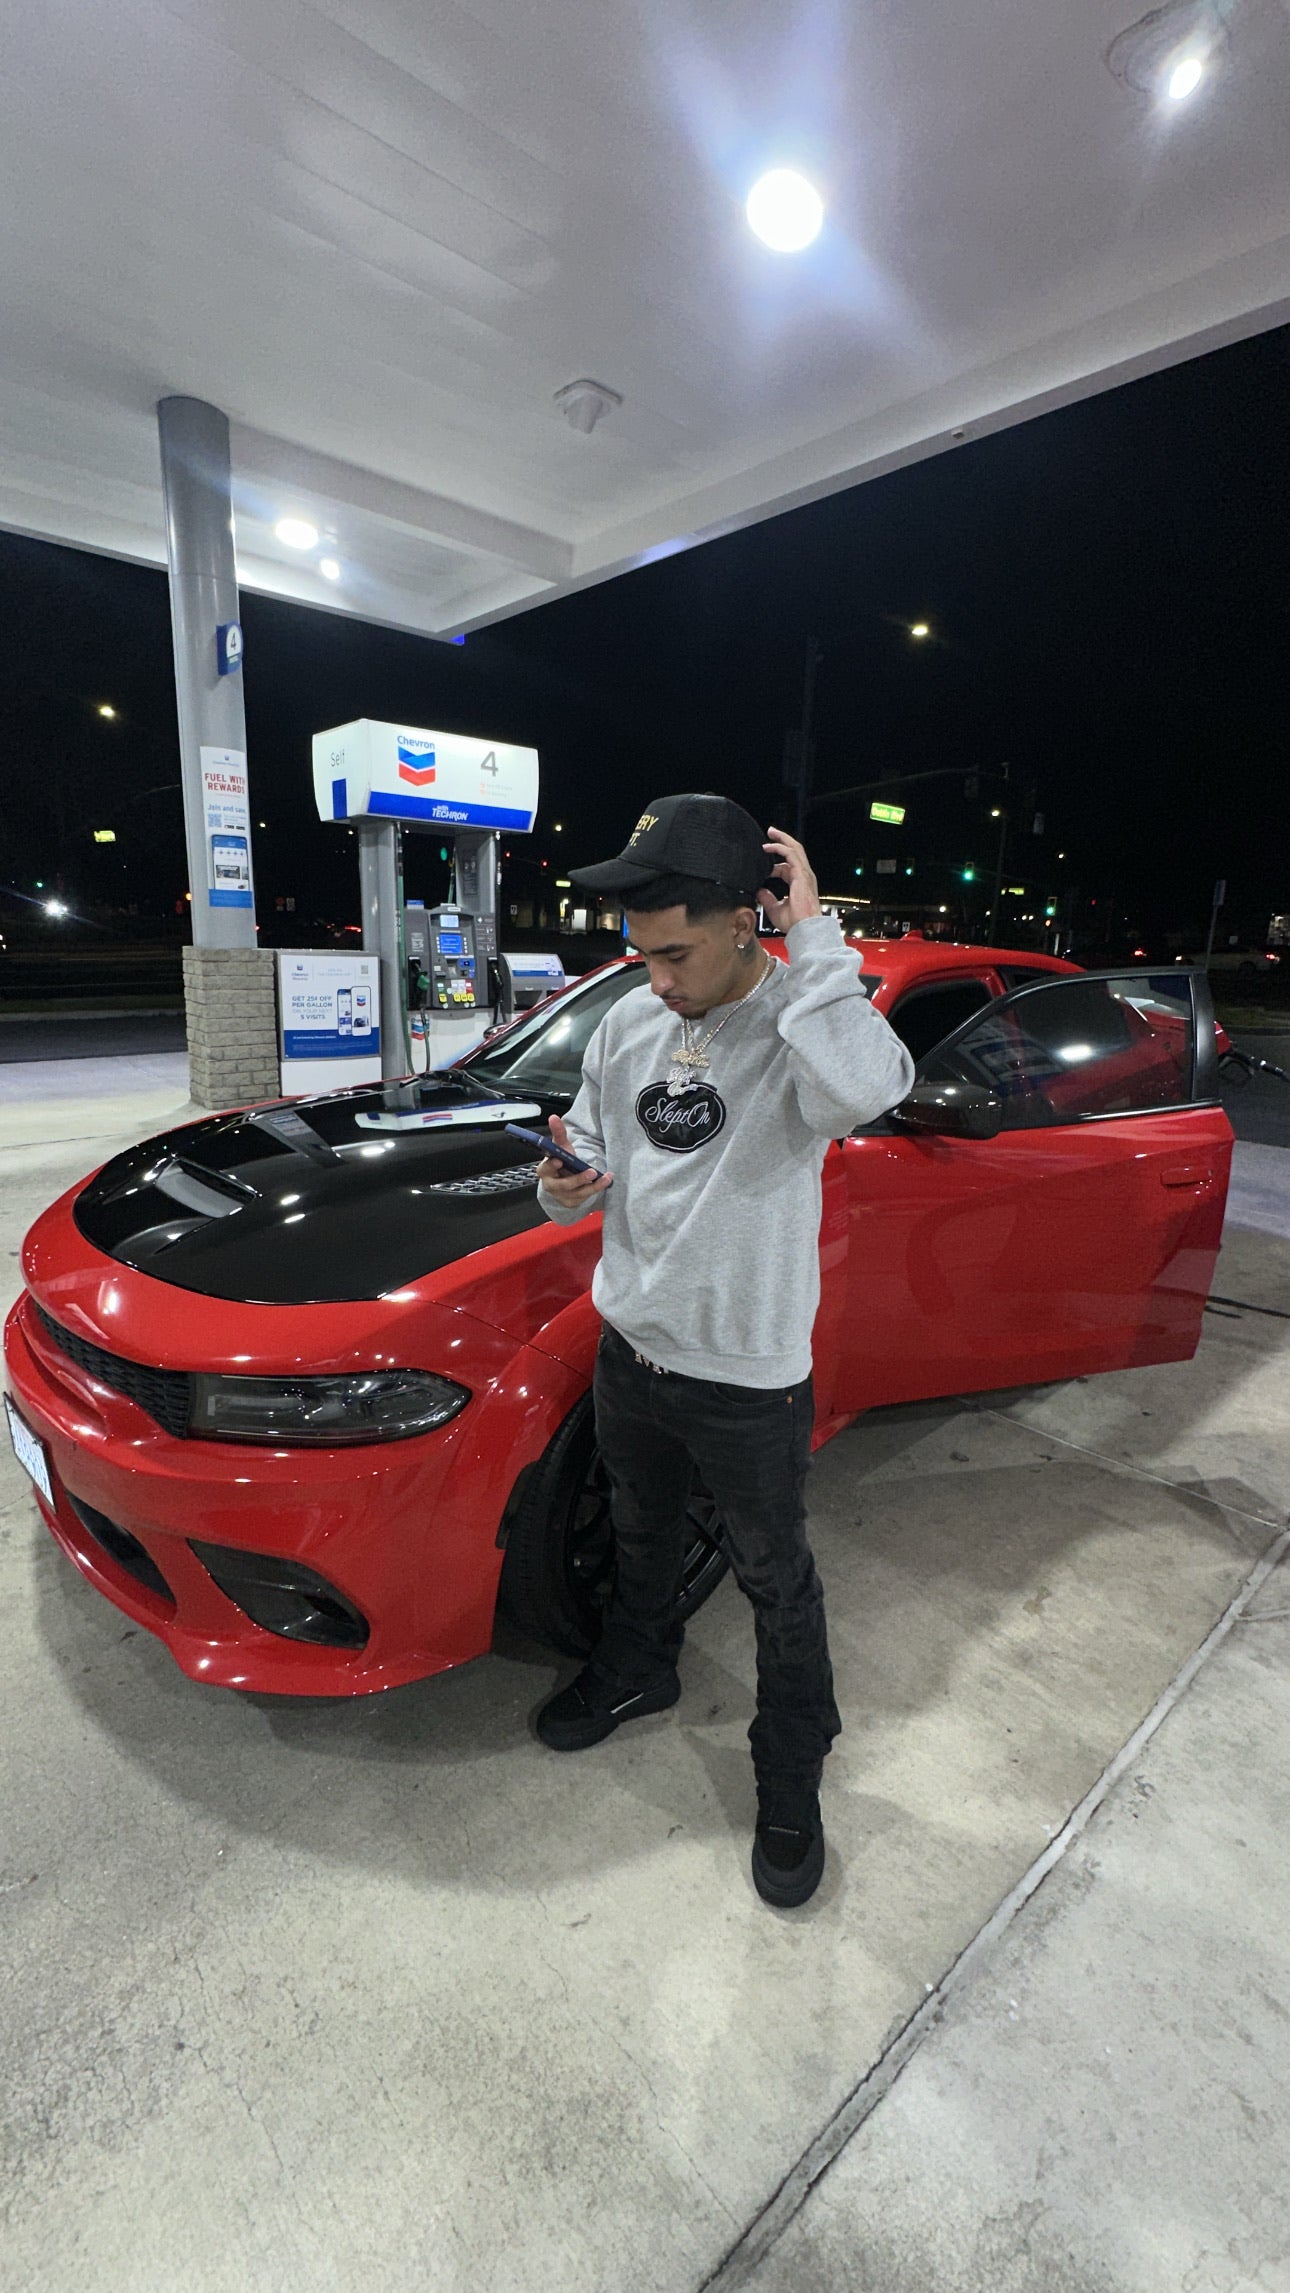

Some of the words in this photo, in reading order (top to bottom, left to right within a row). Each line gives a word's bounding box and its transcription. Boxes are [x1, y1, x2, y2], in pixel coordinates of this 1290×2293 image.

[230, 631, 237, 650] 4
[397, 735, 436, 750] Chevron
[330, 749, 345, 767] Self
[480, 750, 499, 776] 4
[204, 773, 226, 782] FUEL
[207, 782, 245, 795] REWARDS
[432, 807, 469, 821] TECHRON
